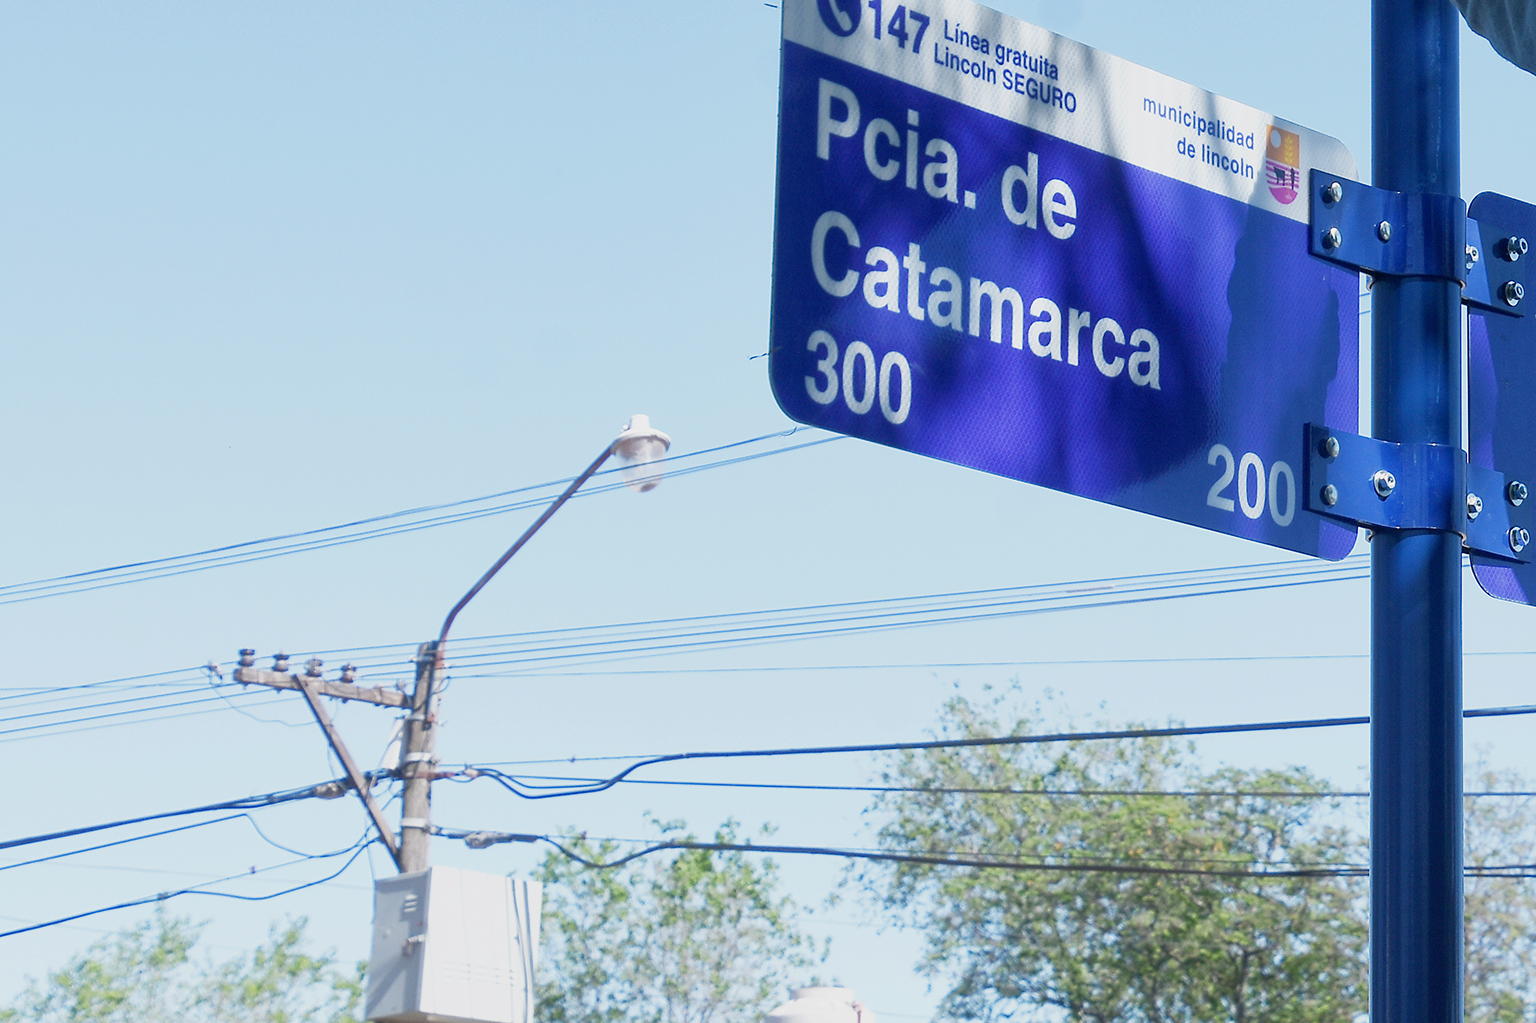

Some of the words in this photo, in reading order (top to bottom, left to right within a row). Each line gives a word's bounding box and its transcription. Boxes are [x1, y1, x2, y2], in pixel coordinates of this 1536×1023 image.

[934, 42, 997, 85] Lincoln
[1002, 69, 1077, 113] SEGURO
[944, 19, 990, 55] Línea
[995, 43, 1059, 81] gratuita
[816, 77, 977, 210] Pcia.
[1000, 152, 1078, 241] de
[1143, 97, 1254, 150] municipalidad
[1177, 137, 1196, 158] de
[1202, 144, 1254, 180] lincoln
[810, 210, 1162, 391] Catamarca
[804, 328, 913, 426] 300
[1206, 443, 1296, 528] 200
